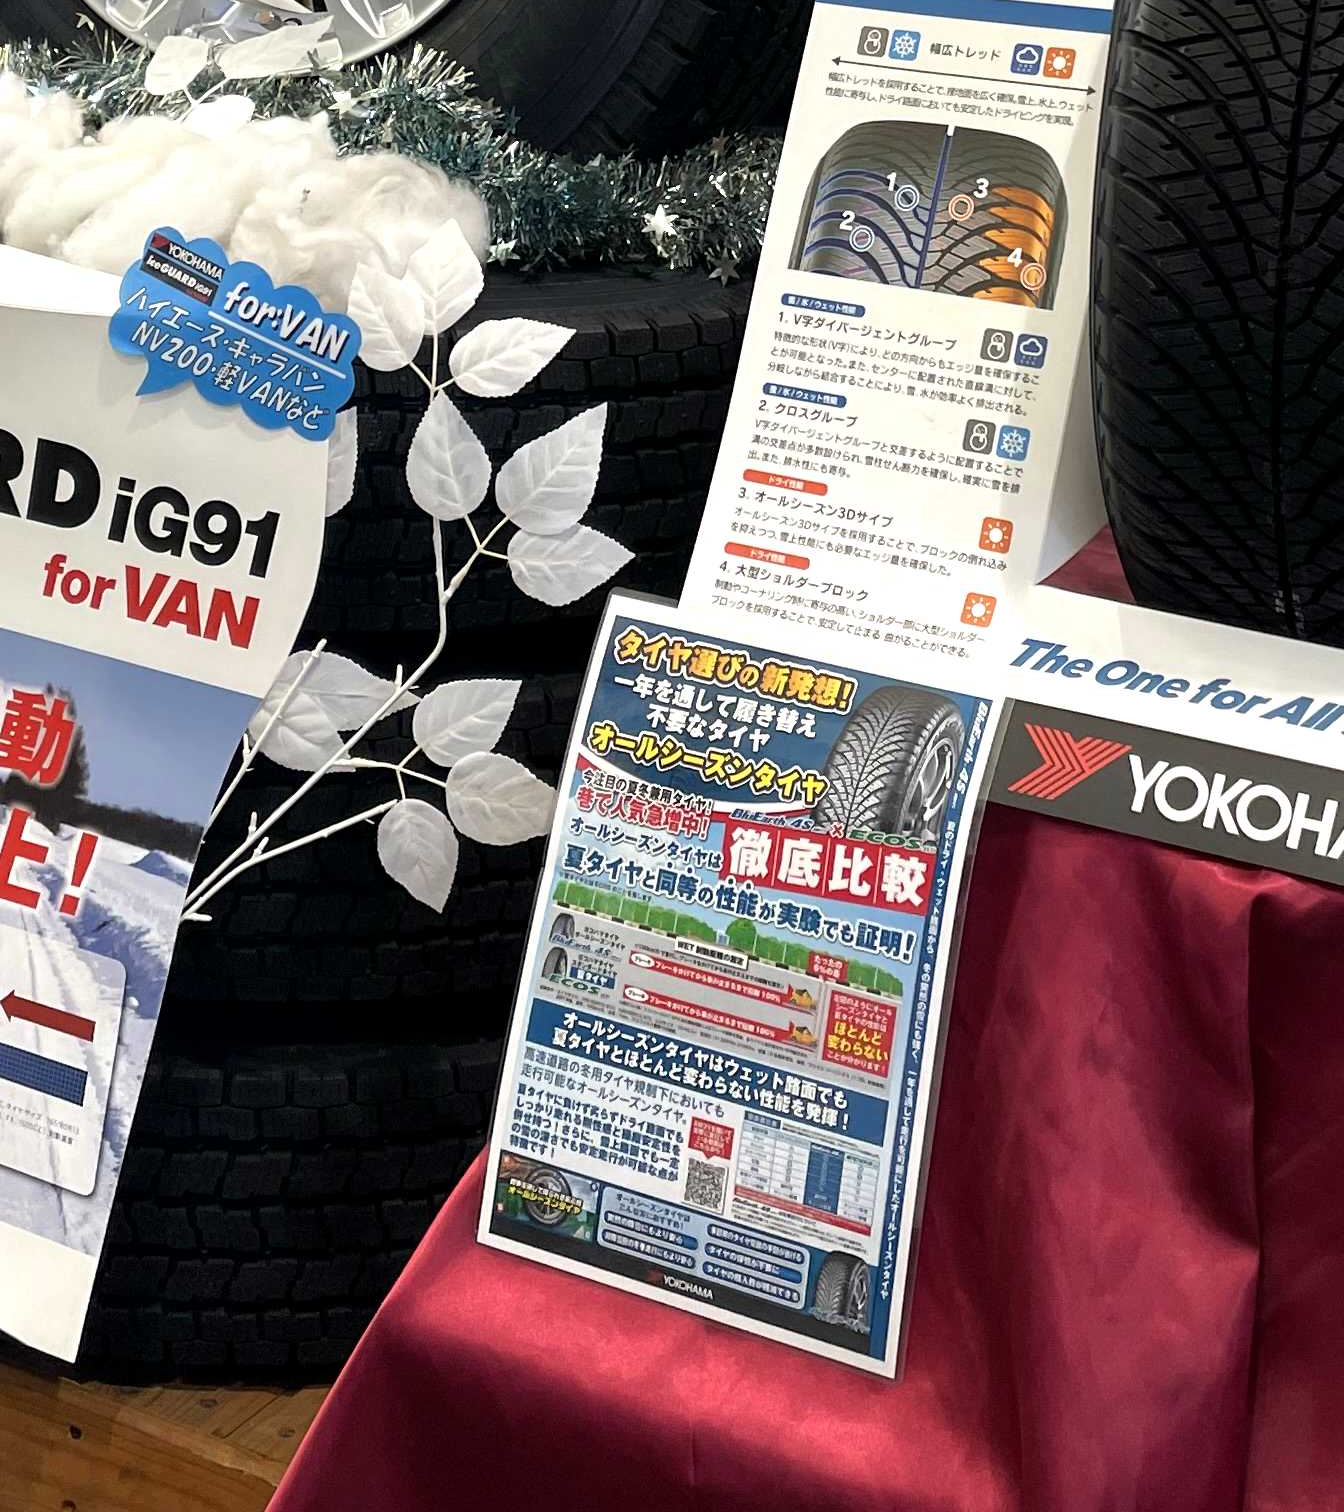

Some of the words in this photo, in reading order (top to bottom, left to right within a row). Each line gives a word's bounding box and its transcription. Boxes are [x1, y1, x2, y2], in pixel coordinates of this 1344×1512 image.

[929, 44, 1001, 61] 幅広トレッド
[168, 243, 224, 281] YOKOHAMA
[127, 287, 325, 392] ハイエース・キャラバン
[132, 321, 325, 430] NV200・軽VANなど
[774, 402, 859, 427] クロスグループ
[108, 479, 282, 579] iG91
[755, 492, 894, 527] オールシーズン3Dサイプ
[44, 554, 117, 611] for
[124, 565, 261, 650] VAN
[735, 564, 870, 601] 大型ショルダーブロック
[616, 629, 857, 710] タイヤ選びの新発想!
[1009, 638, 1093, 680] The
[1095, 660, 1188, 698] One
[1192, 679, 1273, 715] for
[614, 672, 818, 737] 一年を通して履き替え
[646, 704, 770, 752] 不要なタイヤ
[590, 723, 828, 806] オールシーズンタイヤ
[571, 817, 723, 869] オールシーズンタイヤは
[729, 829, 932, 907] 徹底比較
[827, 1036, 889, 1062] 変わらない
[834, 1024, 882, 1044] ほとんど
[663, 1275, 714, 1300] YOKOHAMA
